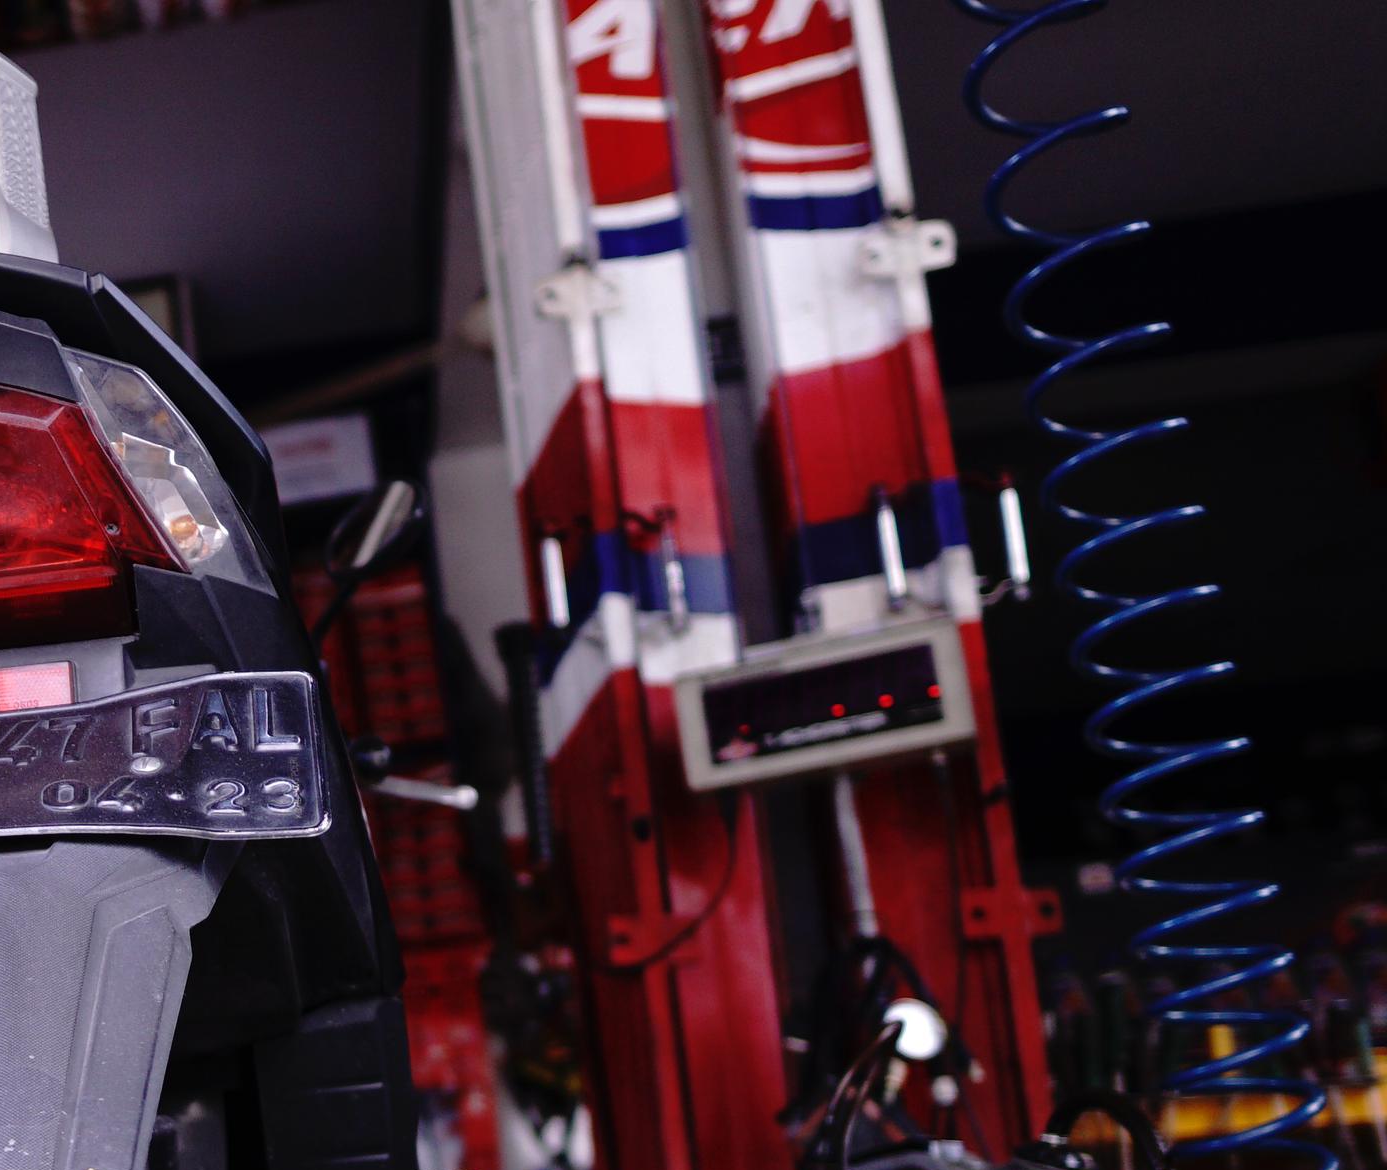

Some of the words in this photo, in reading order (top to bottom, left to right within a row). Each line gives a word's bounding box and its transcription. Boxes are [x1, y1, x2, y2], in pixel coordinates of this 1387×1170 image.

[130, 687, 302, 757] FAL
[40, 775, 146, 814] 04
[204, 777, 299, 816] 23
